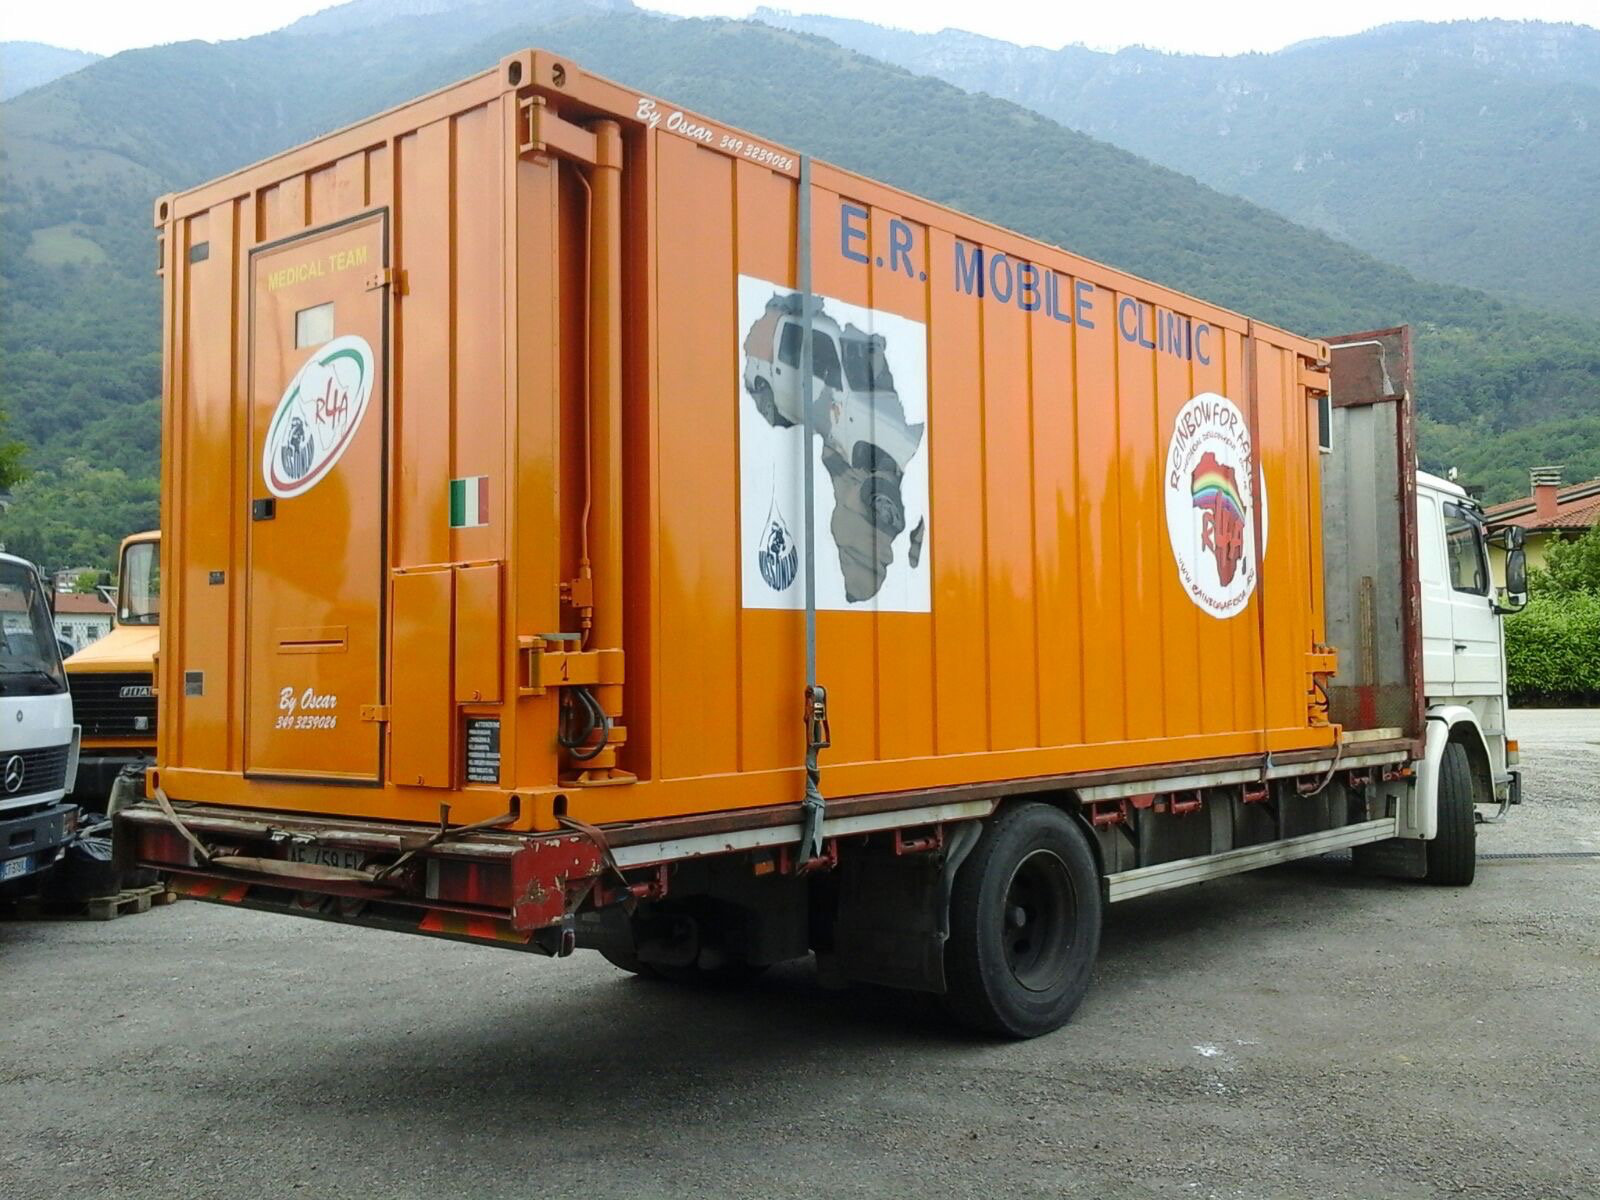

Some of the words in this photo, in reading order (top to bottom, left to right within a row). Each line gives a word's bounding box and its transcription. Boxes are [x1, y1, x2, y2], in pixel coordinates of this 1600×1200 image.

[635, 98, 662, 129] By
[667, 111, 714, 143] Oscar
[720, 135, 743, 152] 349
[743, 144, 793, 170] 3239026
[268, 261, 326, 291] MEDICAL
[329, 246, 368, 273] TEAM
[840, 203, 928, 282] E.R.
[955, 242, 1095, 330] MOBILE
[1118, 297, 1211, 366] CLINIC
[275, 715, 294, 729] 349
[280, 686, 297, 715] By
[301, 687, 337, 709] Oscar
